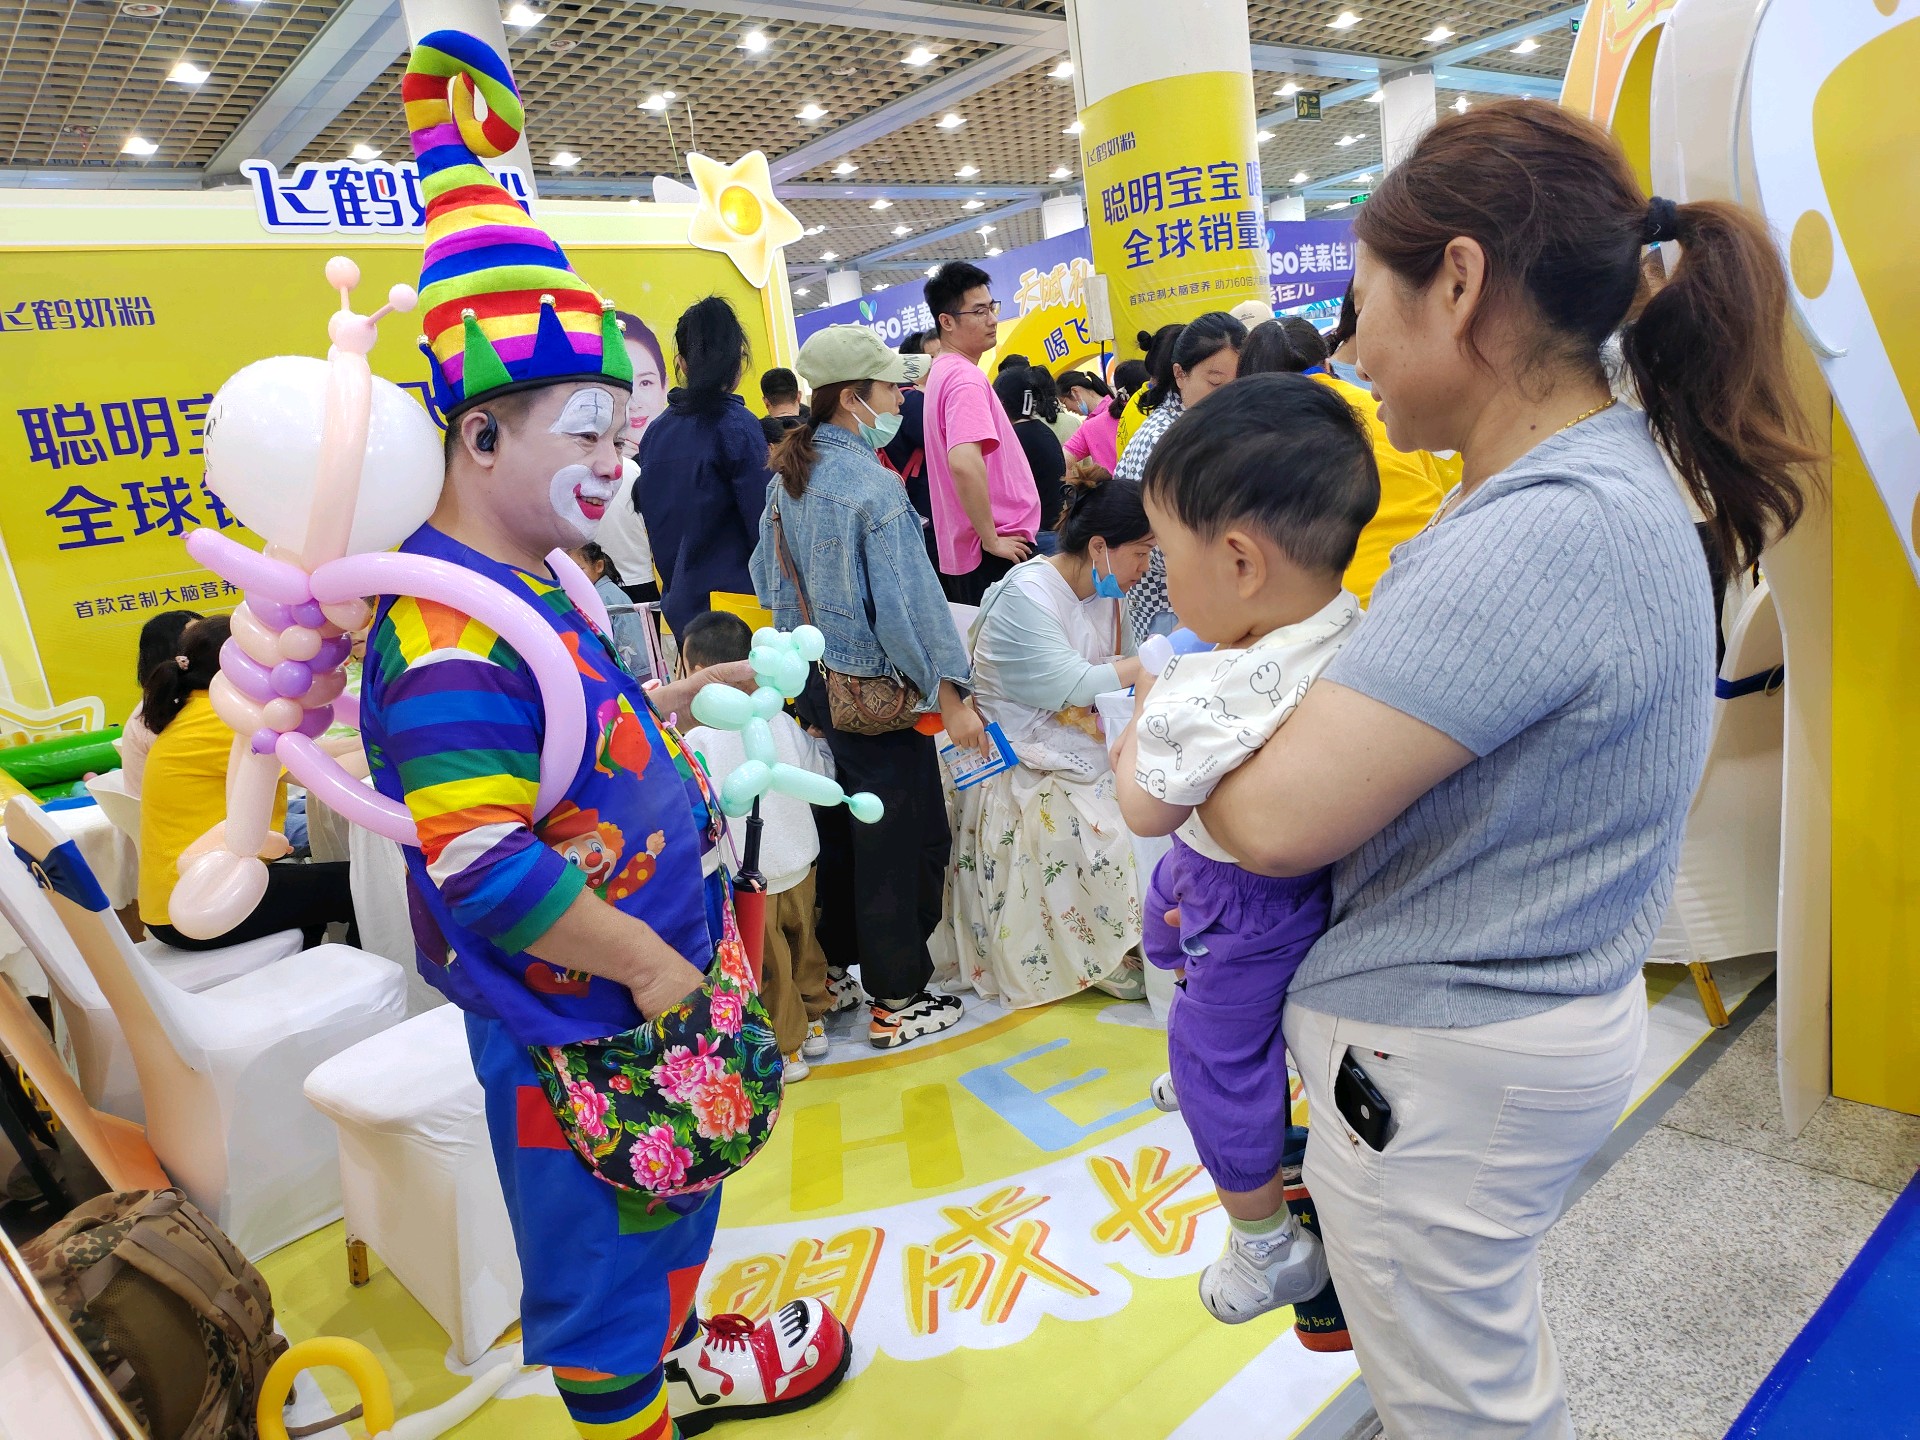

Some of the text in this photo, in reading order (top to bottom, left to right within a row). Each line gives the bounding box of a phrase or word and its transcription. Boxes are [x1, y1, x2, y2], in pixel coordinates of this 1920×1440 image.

[1086, 131, 1136, 167] 飞鹤奶粉
[1101, 161, 1242, 226] 聪明宝宝
[1123, 210, 1266, 270] 全球销量
[1130, 281, 1211, 306] 首款定制大脑营养
[0, 296, 156, 332] 飞鹤奶粉
[1311, 1316, 1336, 1327] Bear
